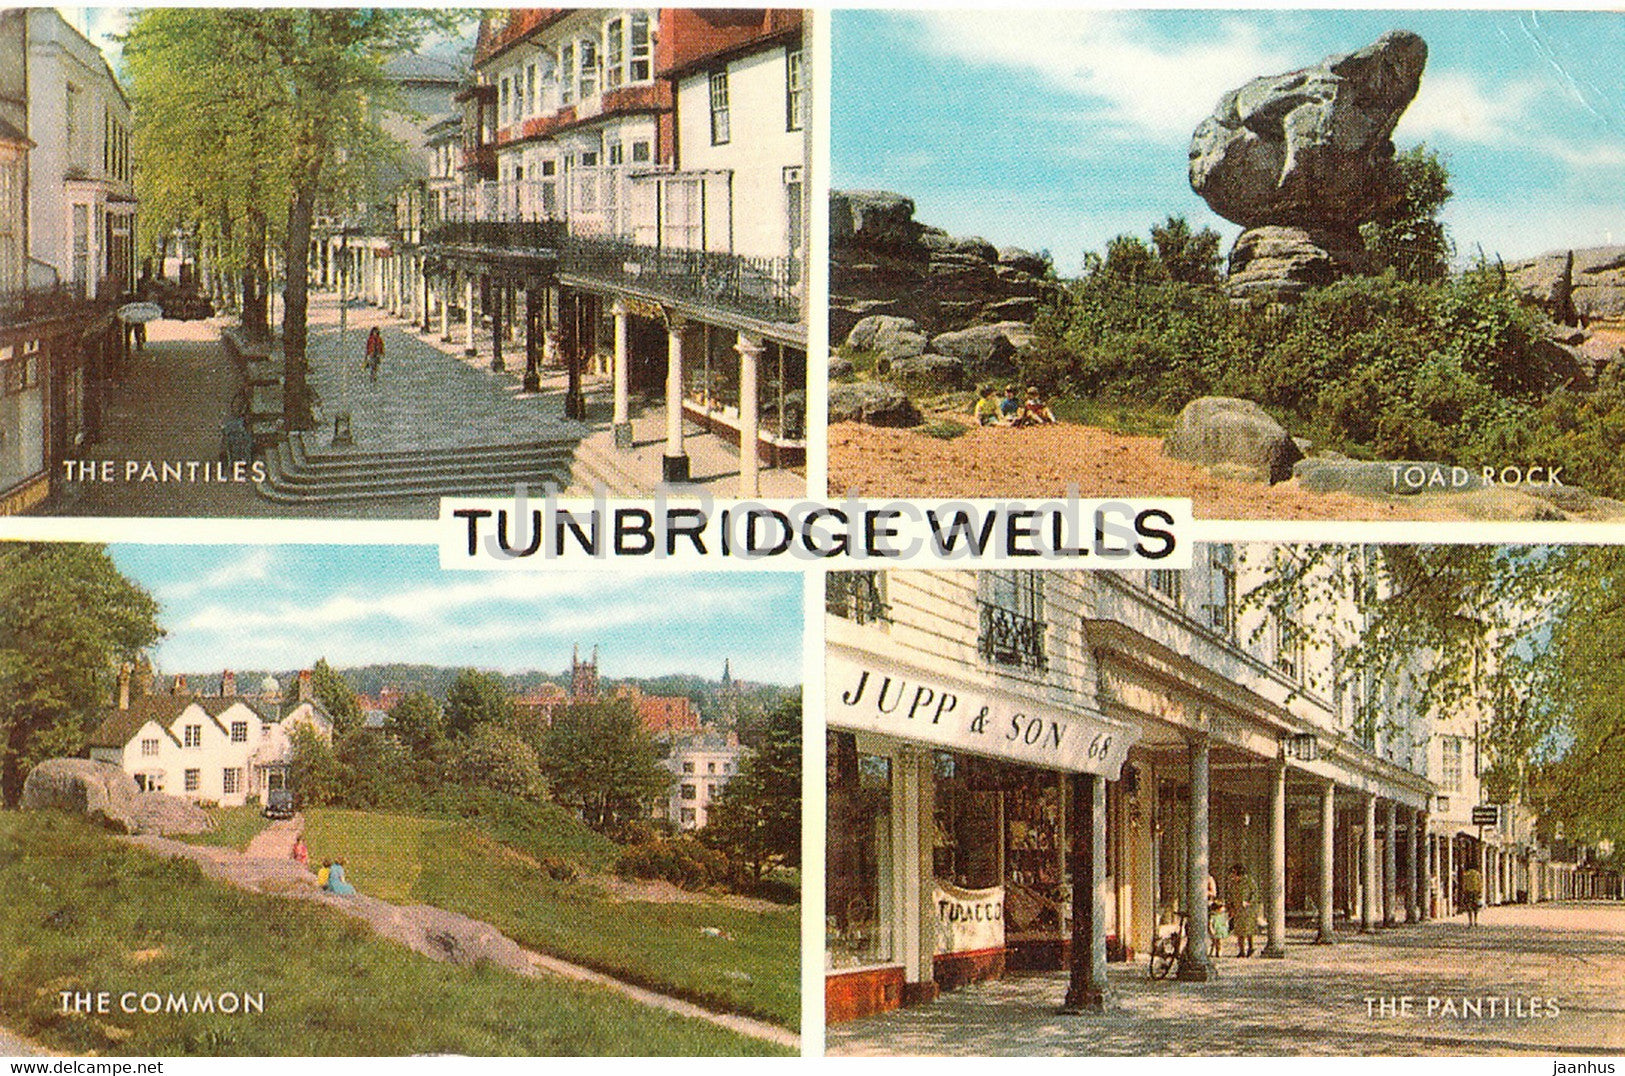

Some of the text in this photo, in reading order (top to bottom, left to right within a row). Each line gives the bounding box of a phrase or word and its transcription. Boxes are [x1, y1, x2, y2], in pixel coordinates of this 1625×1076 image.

[842, 671, 1113, 760] JUPP & SON 68
